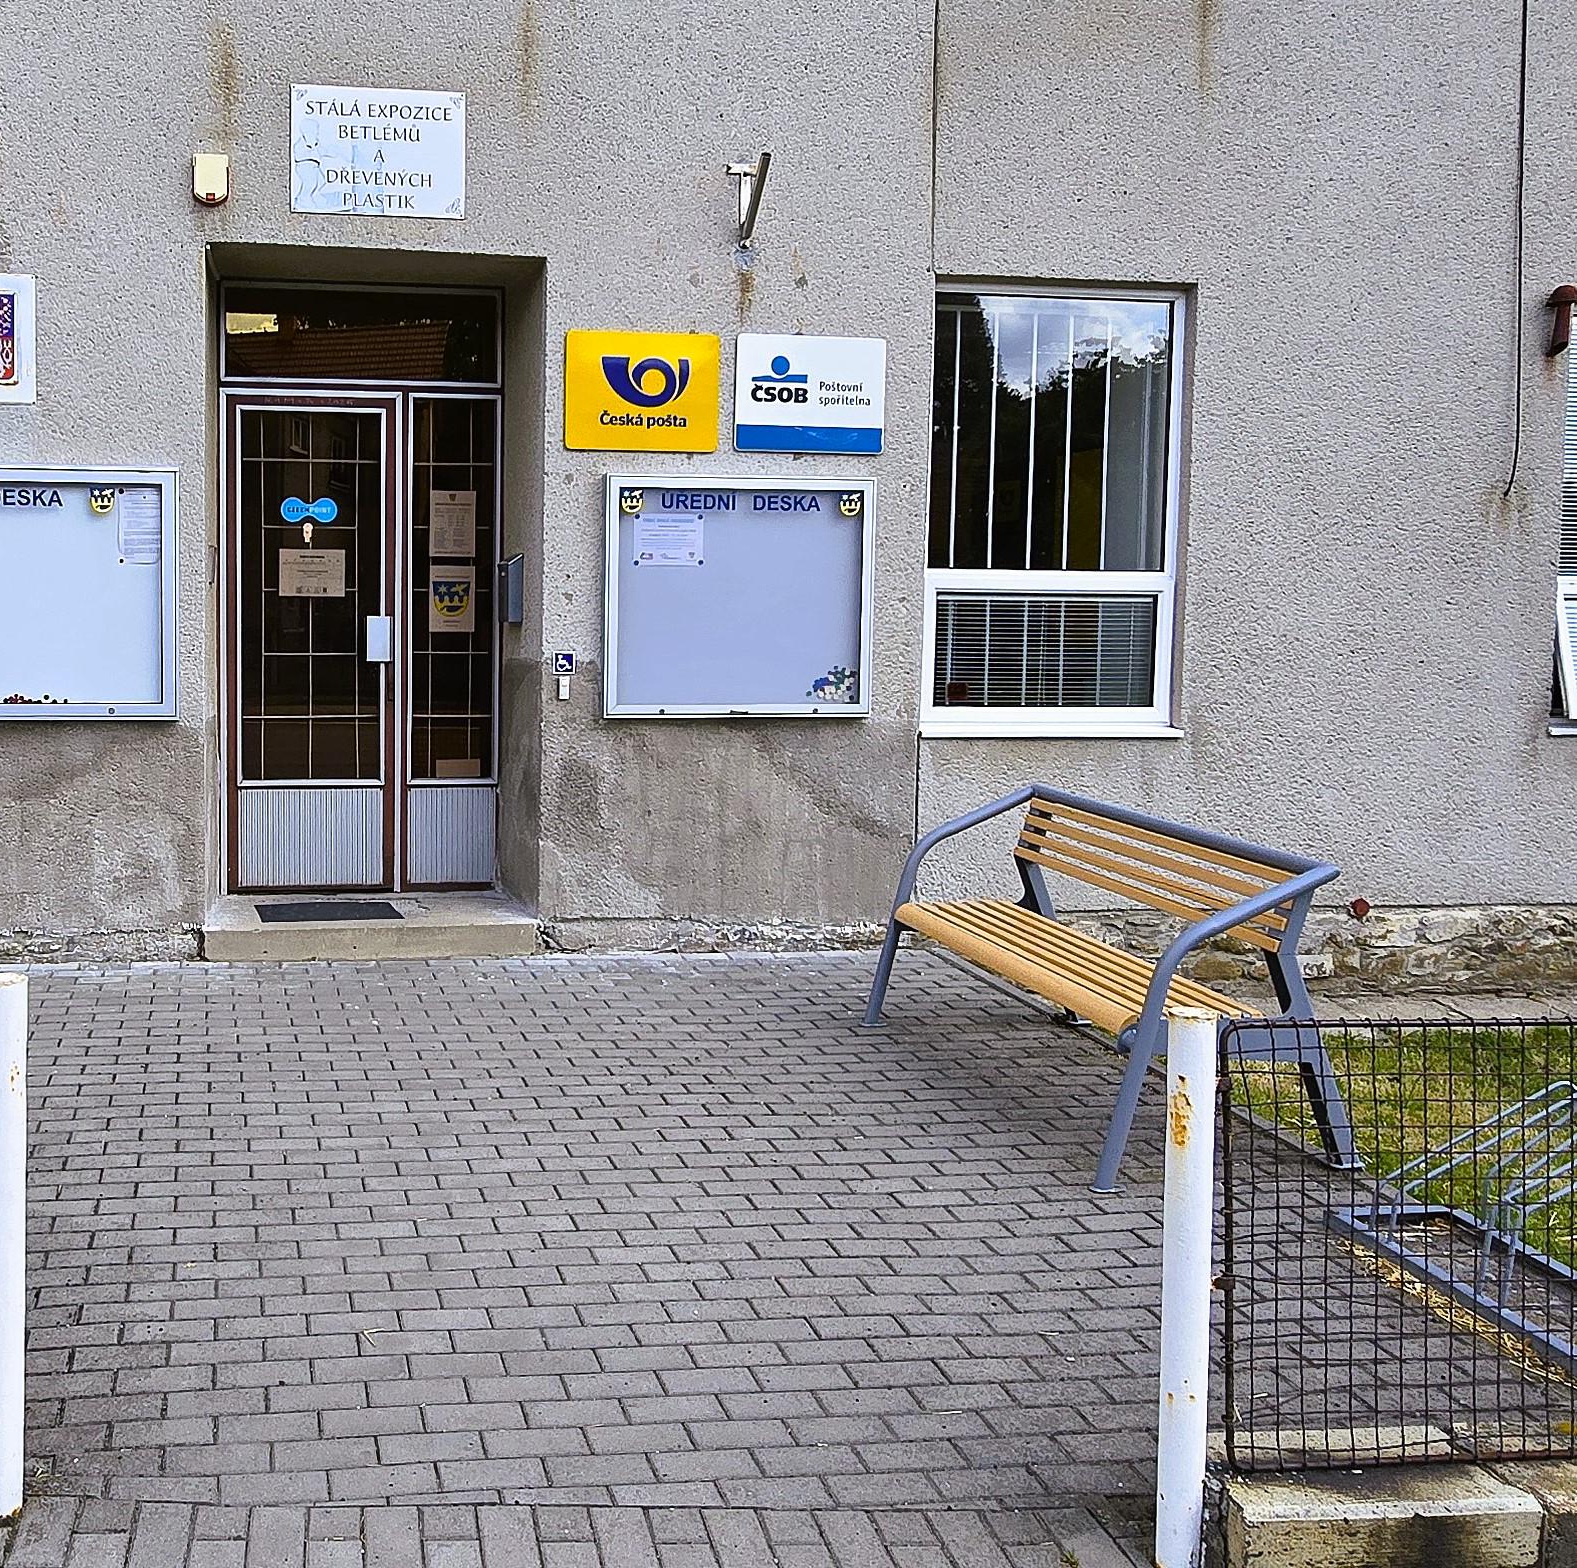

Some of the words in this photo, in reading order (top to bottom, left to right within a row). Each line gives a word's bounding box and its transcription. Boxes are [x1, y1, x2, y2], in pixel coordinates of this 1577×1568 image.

[305, 98, 361, 117] STÁLÁ
[368, 103, 453, 121] EXPOZICE
[338, 123, 421, 142] BETLÉMŮ
[373, 149, 385, 163] A
[326, 167, 432, 188] DŘEVENÝCH
[343, 192, 415, 209] PLASTIK
[750, 384, 808, 404] ČSOB
[819, 381, 864, 392] Poštovní
[819, 394, 871, 406] spořitelna
[599, 410, 644, 427] Česká
[646, 412, 687, 429] pošta
[753, 494, 821, 512] DESKA
